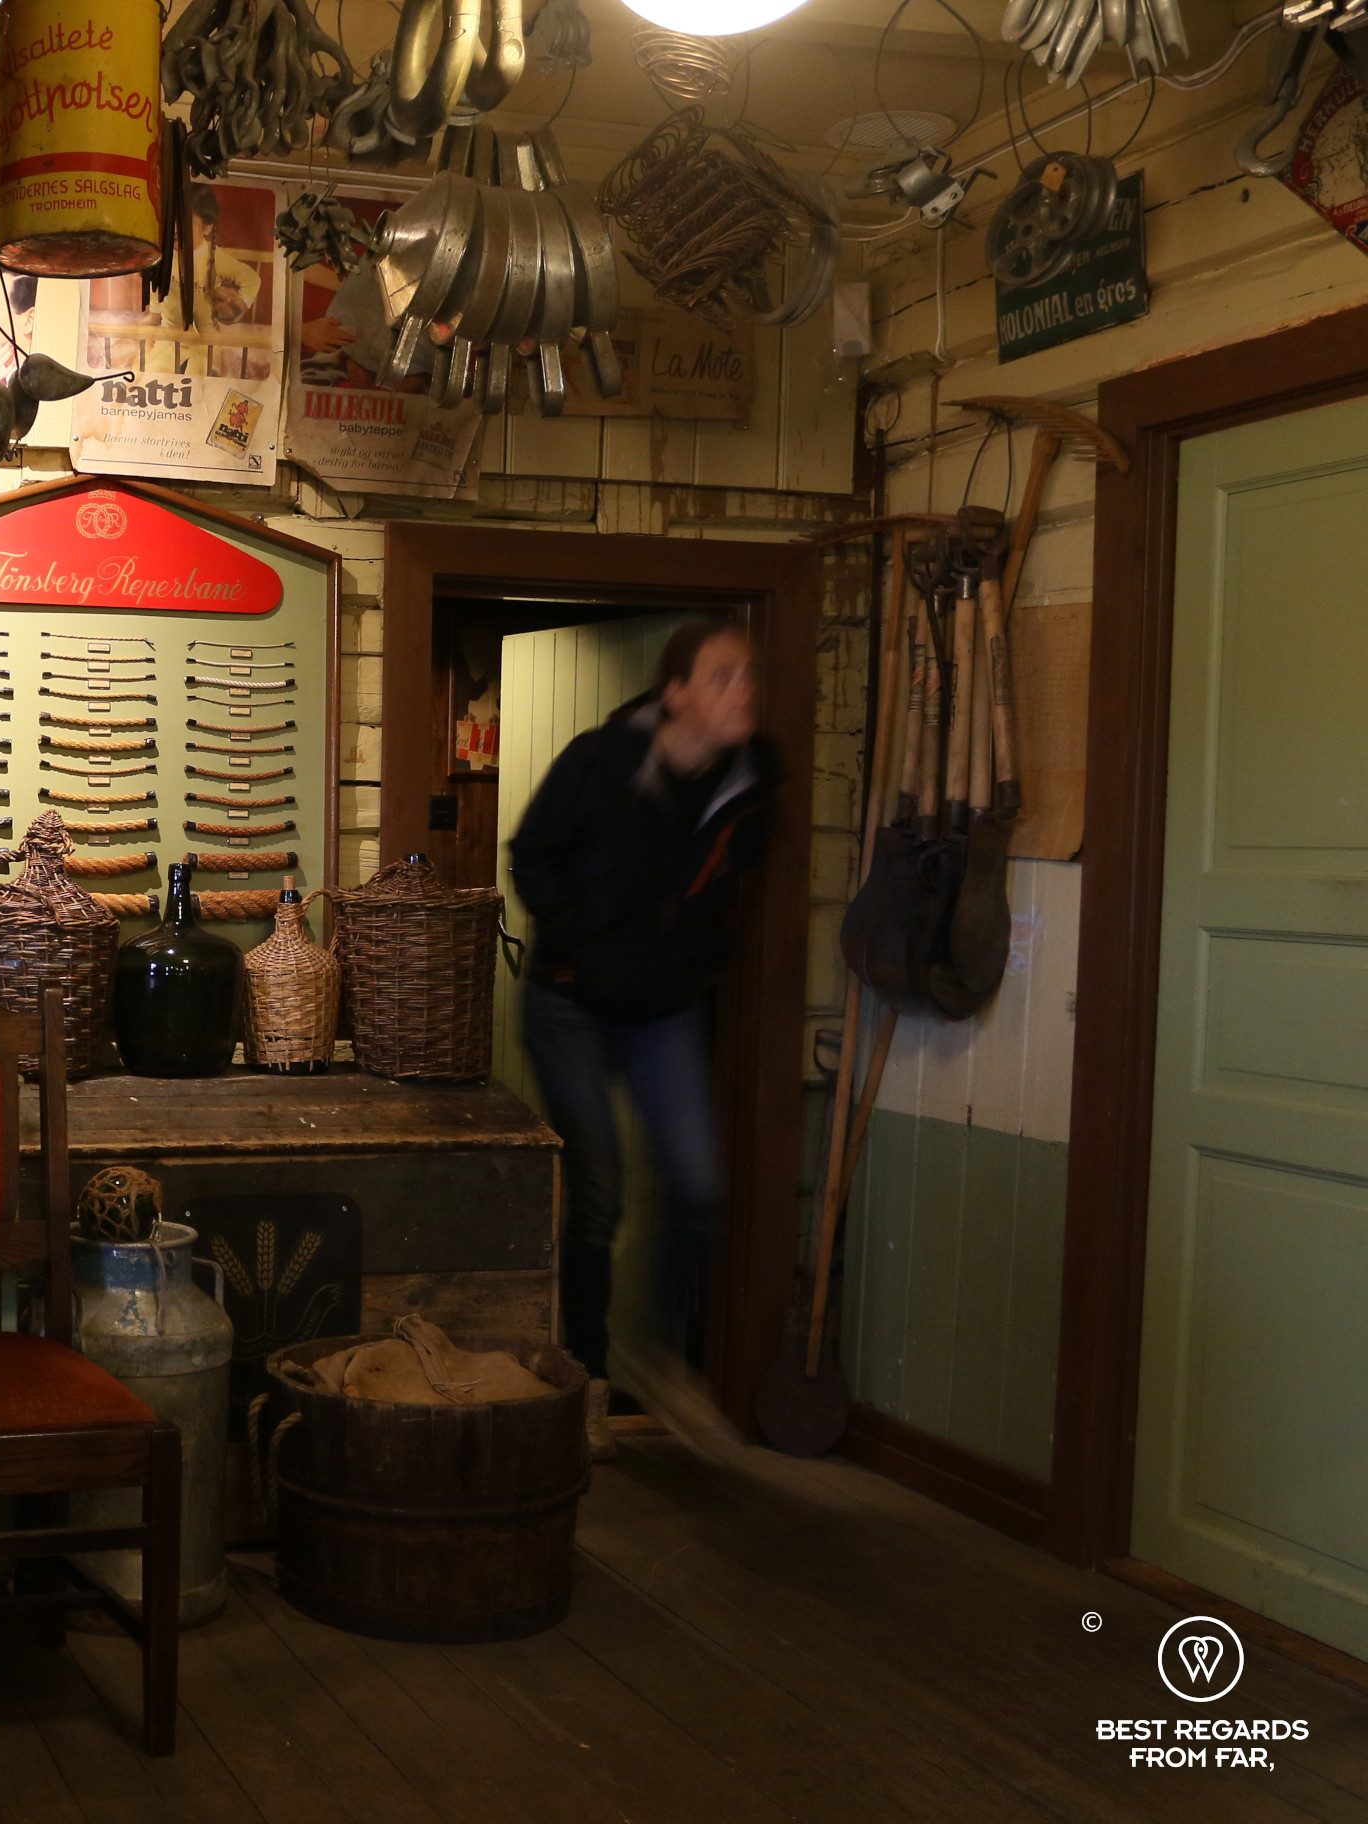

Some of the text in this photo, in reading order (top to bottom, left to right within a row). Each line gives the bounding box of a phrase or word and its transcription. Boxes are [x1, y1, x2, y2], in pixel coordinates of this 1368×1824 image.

[75, 179, 140, 201] SALGSLAG
[31, 198, 97, 213] TRONDHEIM
[1075, 292, 1094, 317] en
[1097, 278, 1137, 312] gros
[652, 337, 686, 378] La
[101, 378, 192, 409] natti
[101, 406, 192, 421] barnepyjamas
[339, 422, 403, 437] babyteppe
[141, 437, 191, 448] stortrives
[167, 449, 191, 459] den!
